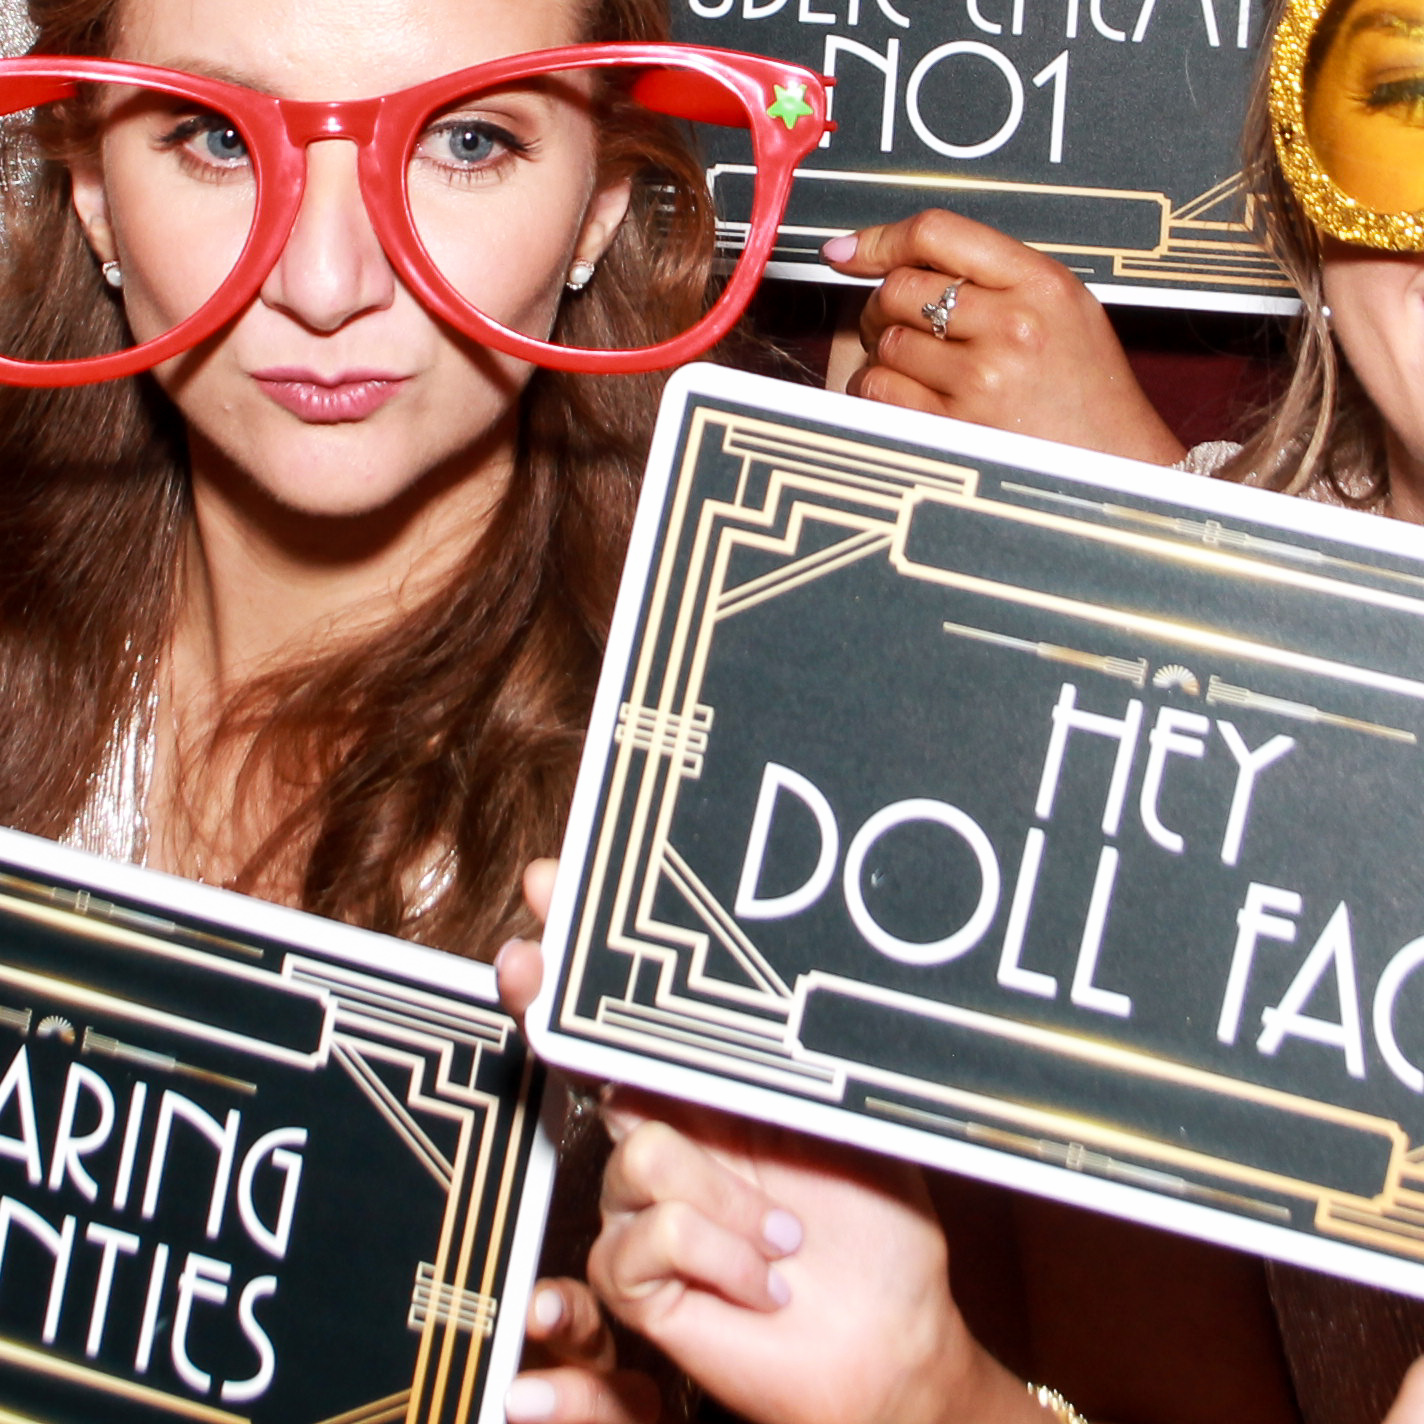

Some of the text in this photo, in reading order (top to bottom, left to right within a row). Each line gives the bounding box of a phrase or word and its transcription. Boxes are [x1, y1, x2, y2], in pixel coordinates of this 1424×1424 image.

[818, 34, 1068, 163] NO1
[1036, 681, 1294, 865] HEY
[735, 762, 1132, 1015] DOLL
